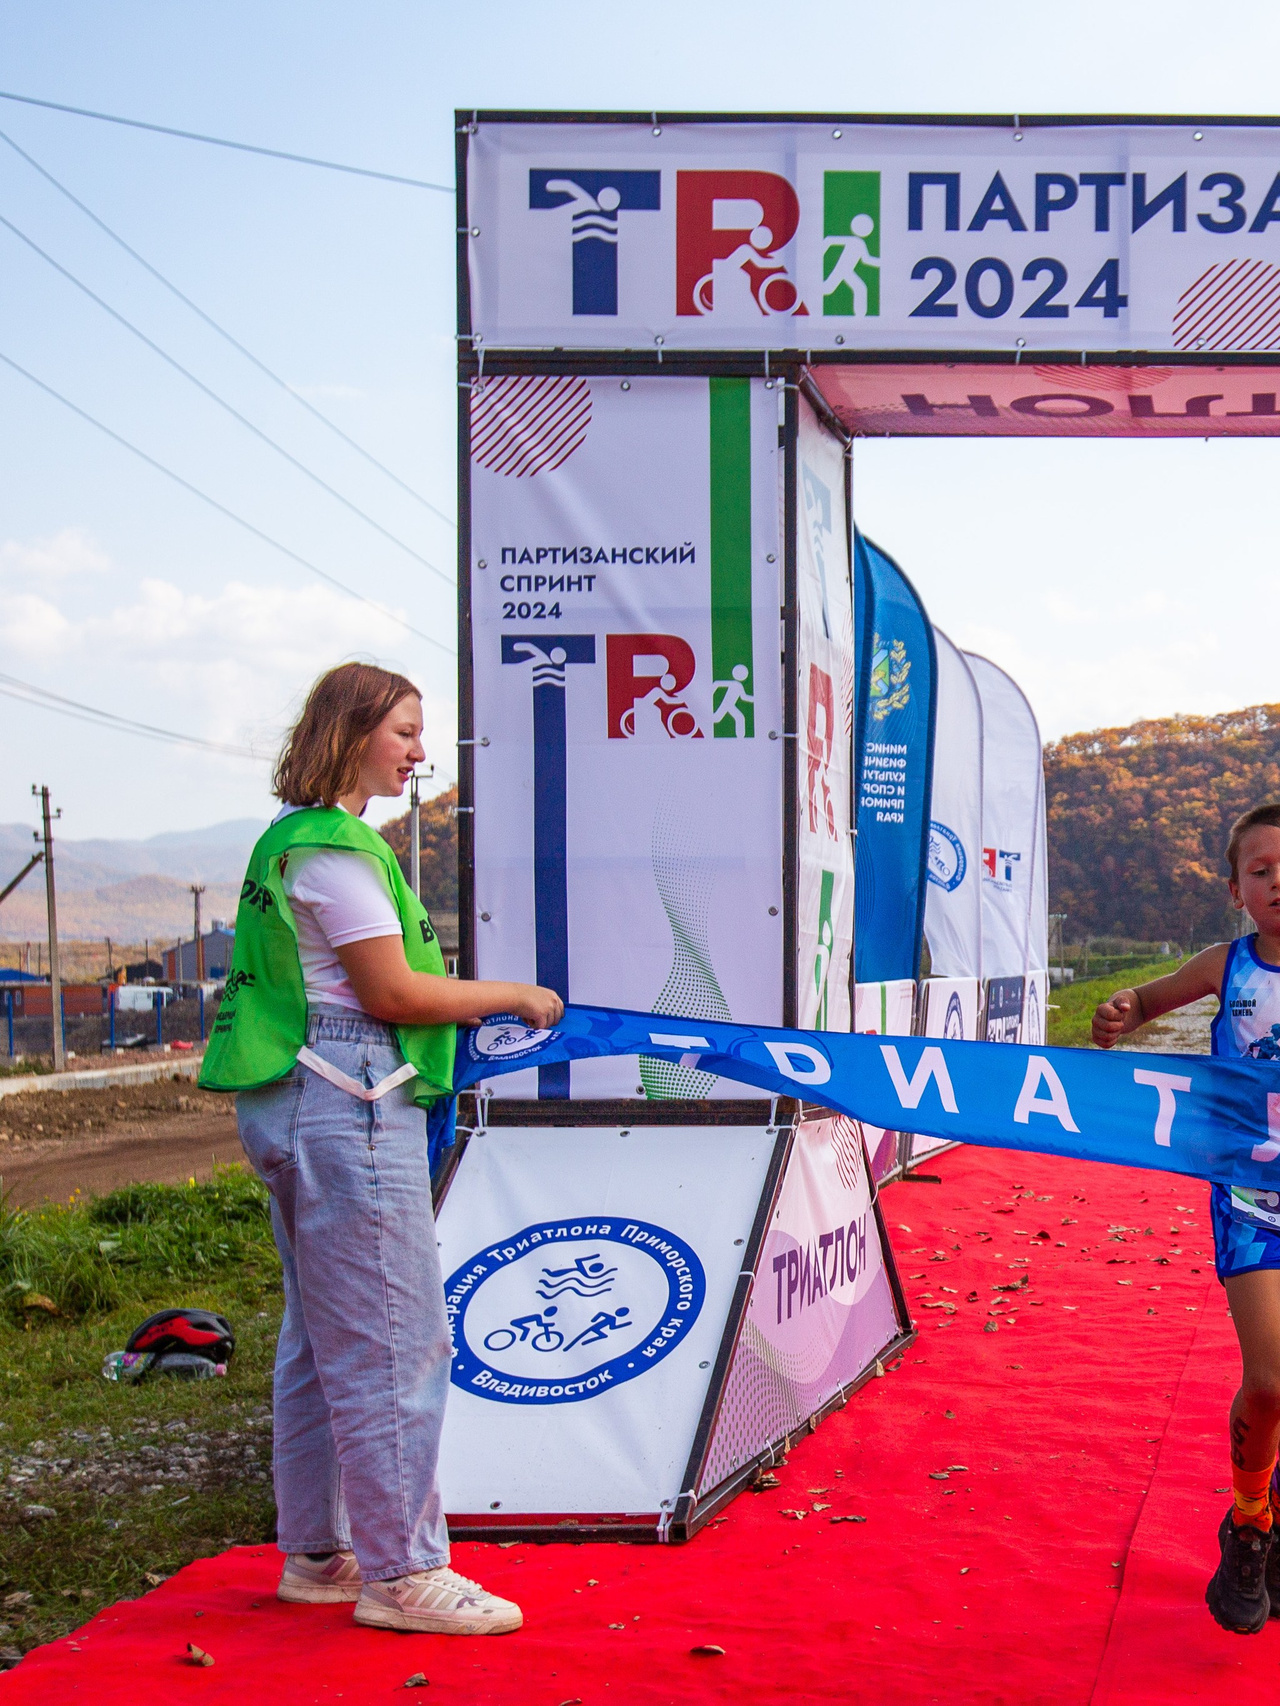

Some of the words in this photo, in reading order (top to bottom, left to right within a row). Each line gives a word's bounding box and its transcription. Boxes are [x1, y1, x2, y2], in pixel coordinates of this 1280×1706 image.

[907, 256, 1130, 319] 2024
[500, 541, 696, 566] ПАРТИЗАНСКИЙ
[500, 574, 597, 593] СПРИНТ
[502, 602, 563, 620] 2024
[487, 1223, 612, 1263] Триатлона
[621, 1224, 694, 1311] Приморского
[772, 1213, 867, 1325] ТРИАТЛОН
[642, 1318, 684, 1358] края
[471, 1369, 614, 1397] Владивосток
